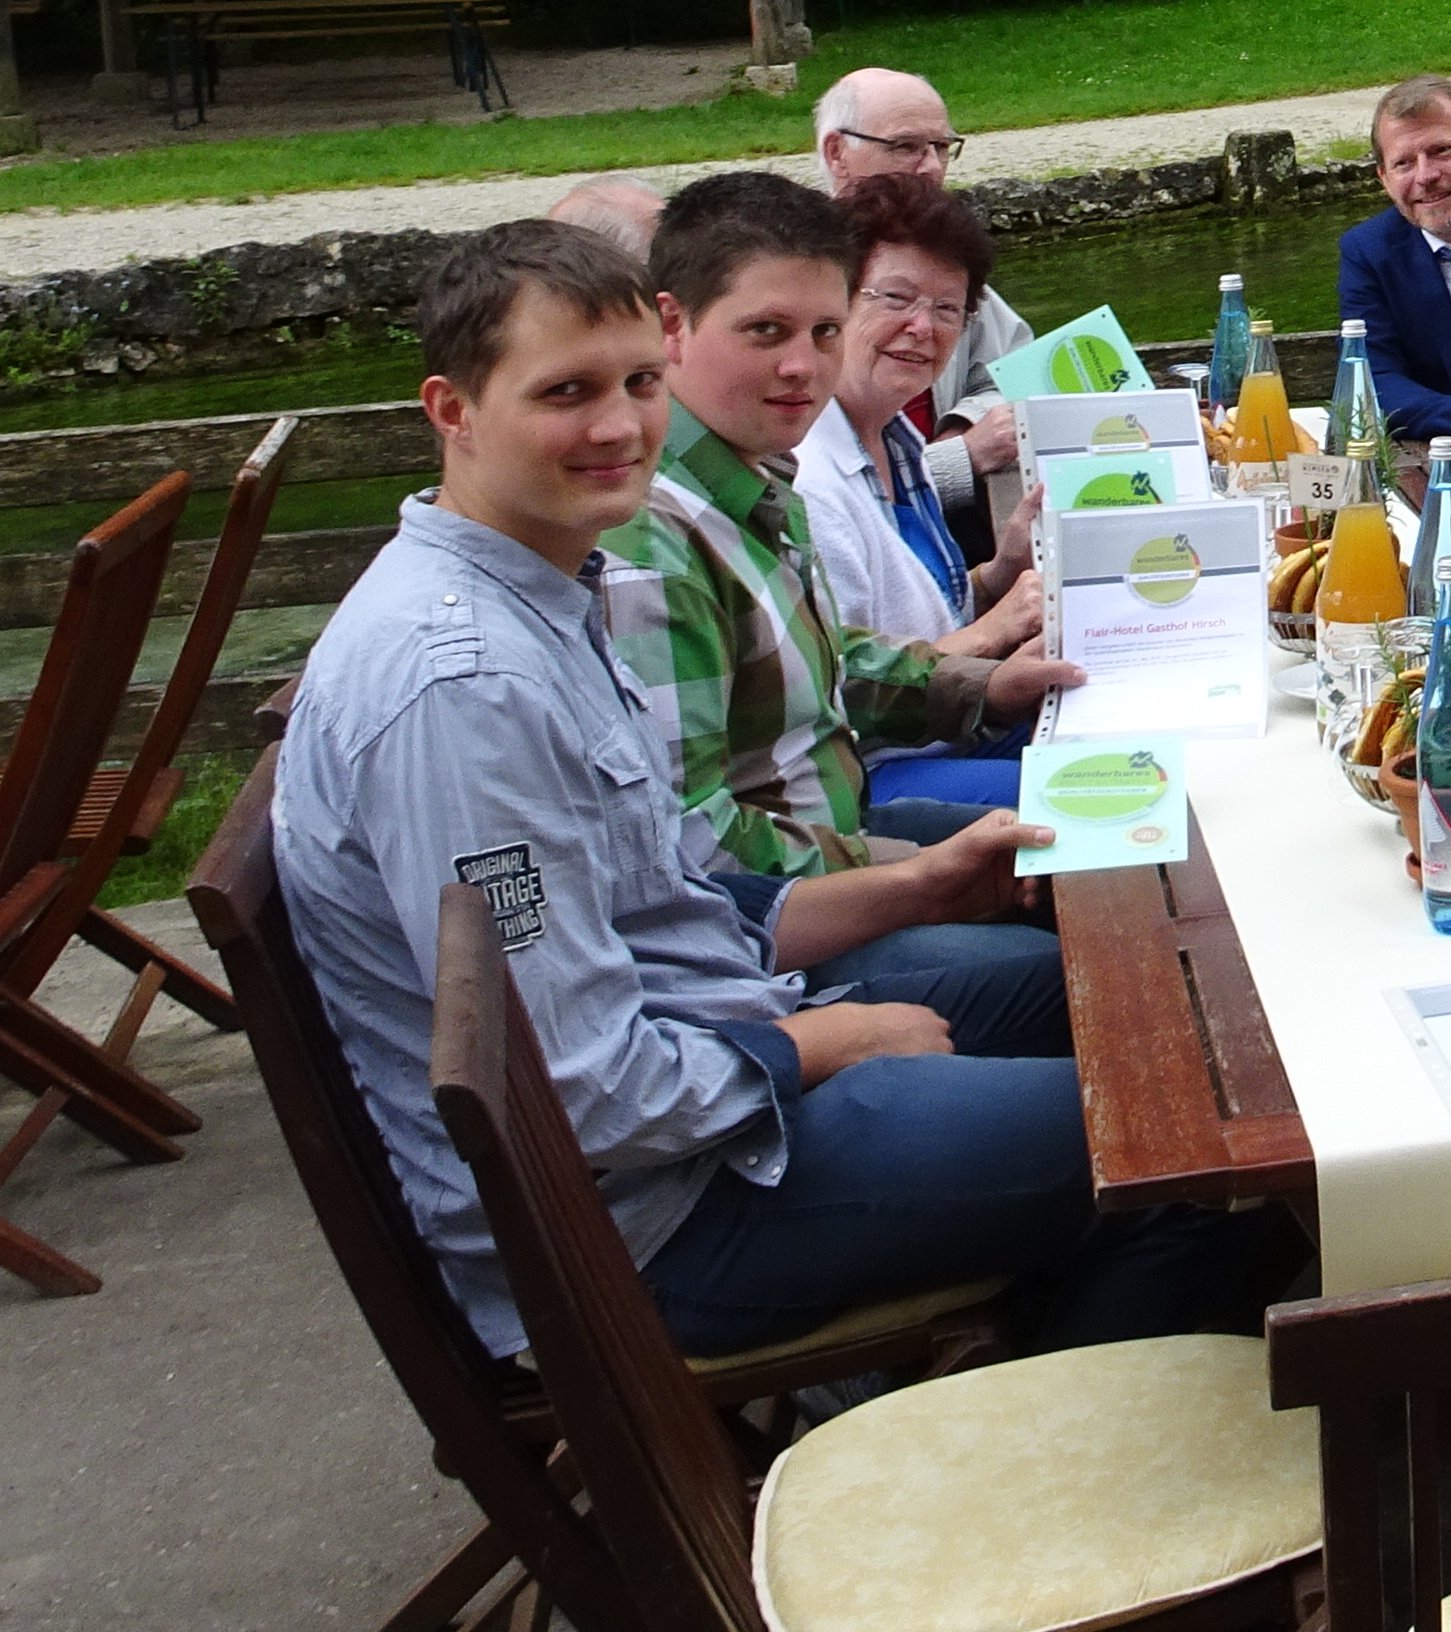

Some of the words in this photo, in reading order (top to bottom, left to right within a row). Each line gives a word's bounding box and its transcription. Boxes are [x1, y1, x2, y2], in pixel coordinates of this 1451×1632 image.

[1311, 481, 1333, 500] 35
[1084, 624, 1143, 638] Flair-Hotel
[1146, 621, 1188, 634] Gasthof
[1191, 617, 1226, 629] Hirsch
